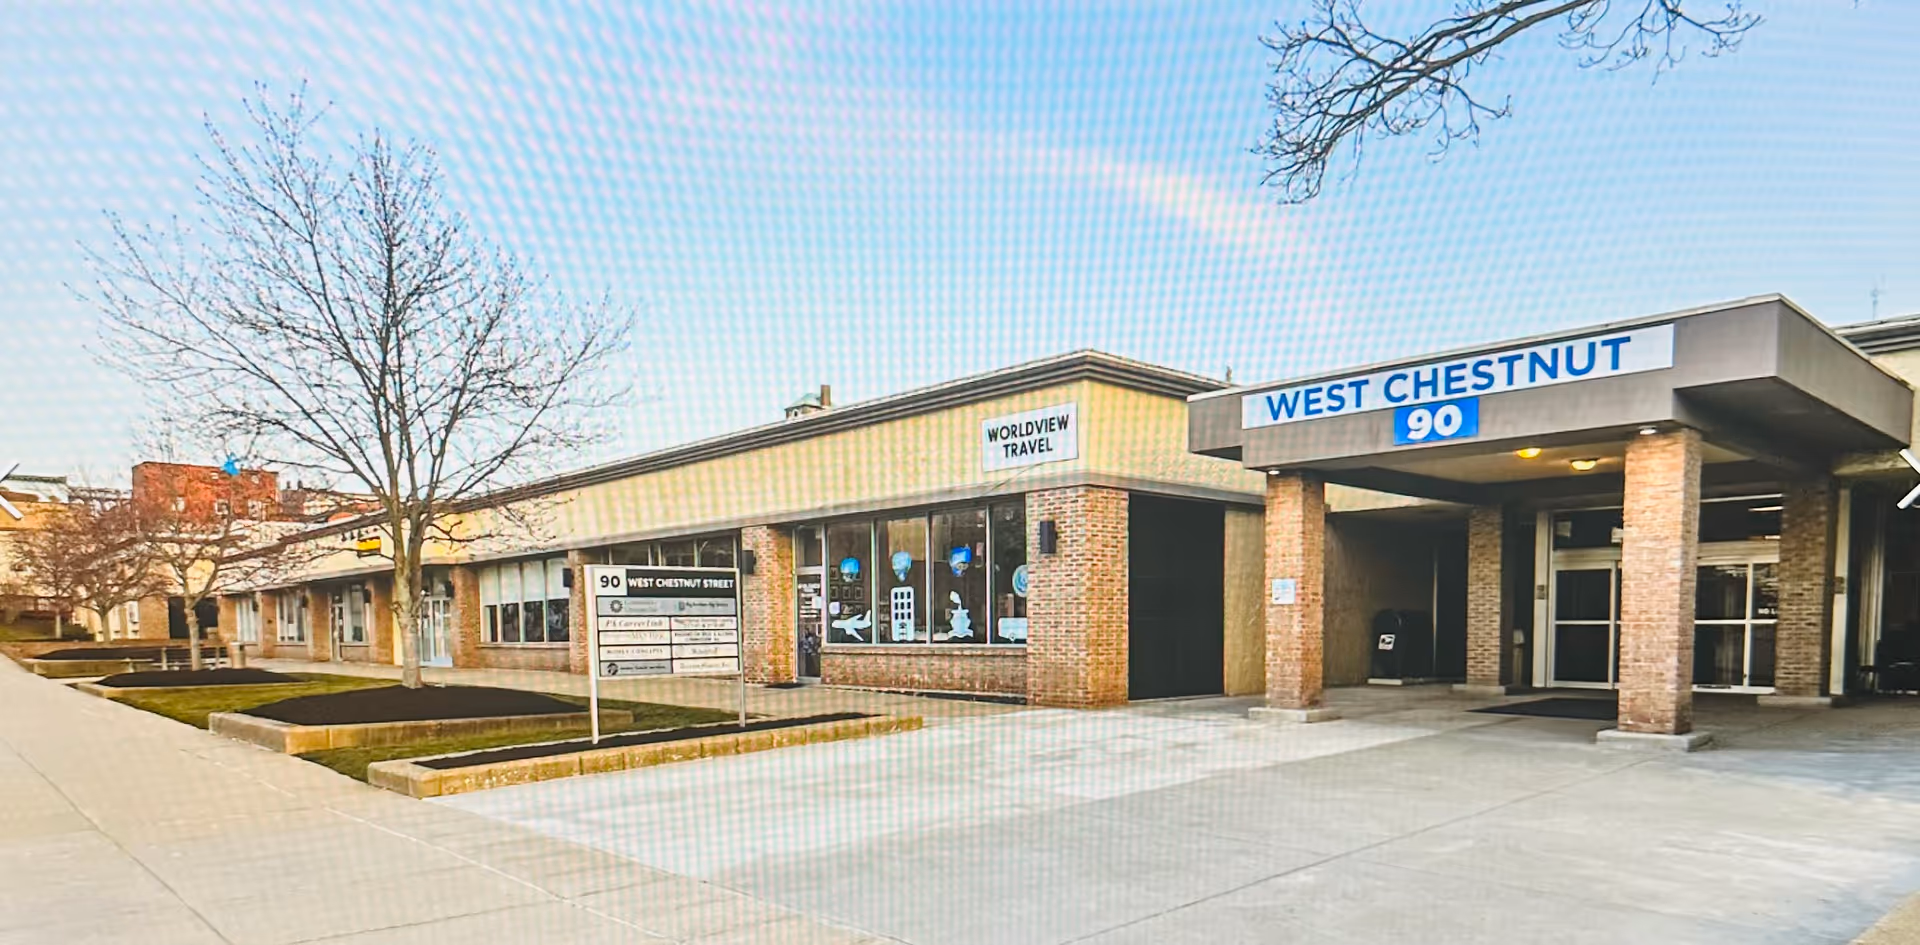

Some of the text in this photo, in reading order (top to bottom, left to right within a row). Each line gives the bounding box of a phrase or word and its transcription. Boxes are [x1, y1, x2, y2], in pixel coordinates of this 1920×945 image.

[1266, 336, 1631, 421] WEST CHESTNUT
[988, 414, 1069, 442] WORLDVIEW
[1407, 404, 1463, 440] 90
[1003, 437, 1053, 458] TRAVEL
[600, 575, 734, 589] 90 WEST CHESTNUT STREET
